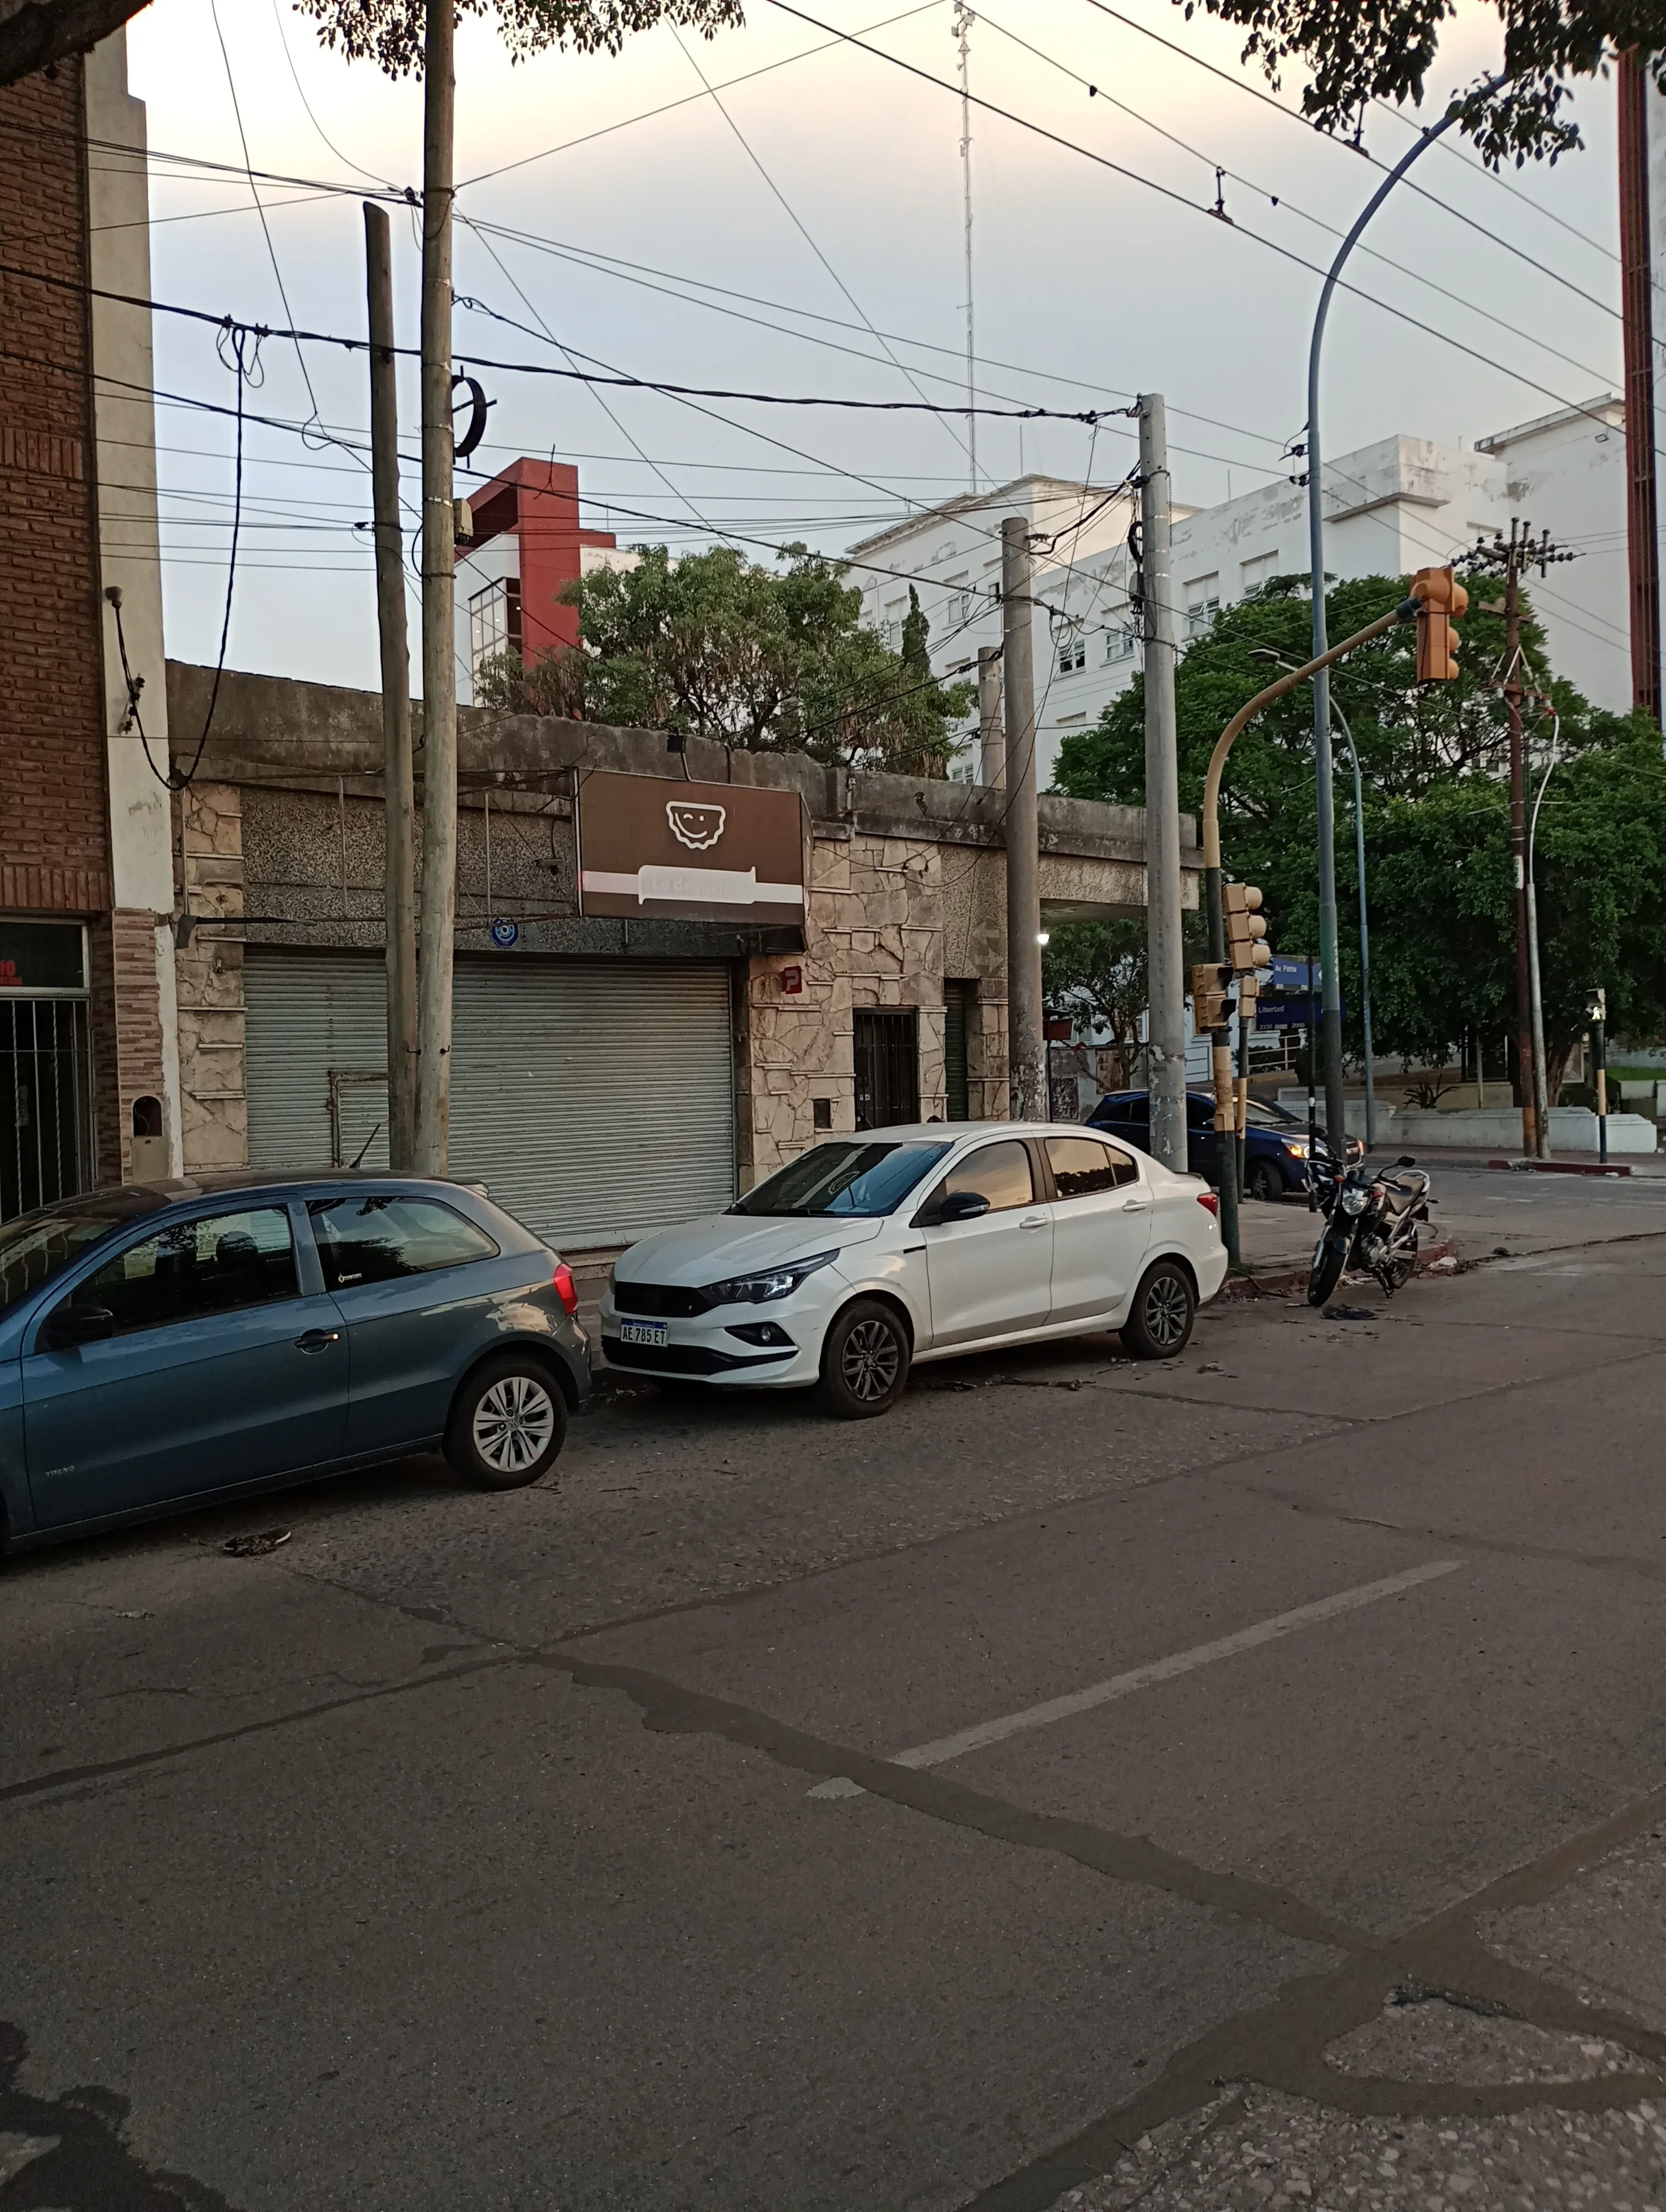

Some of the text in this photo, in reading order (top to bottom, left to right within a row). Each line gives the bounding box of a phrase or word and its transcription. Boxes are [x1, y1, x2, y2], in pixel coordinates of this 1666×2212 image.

[1258, 1005, 1284, 1013] Libertad
[623, 1326, 665, 1344] AE 785 ET
